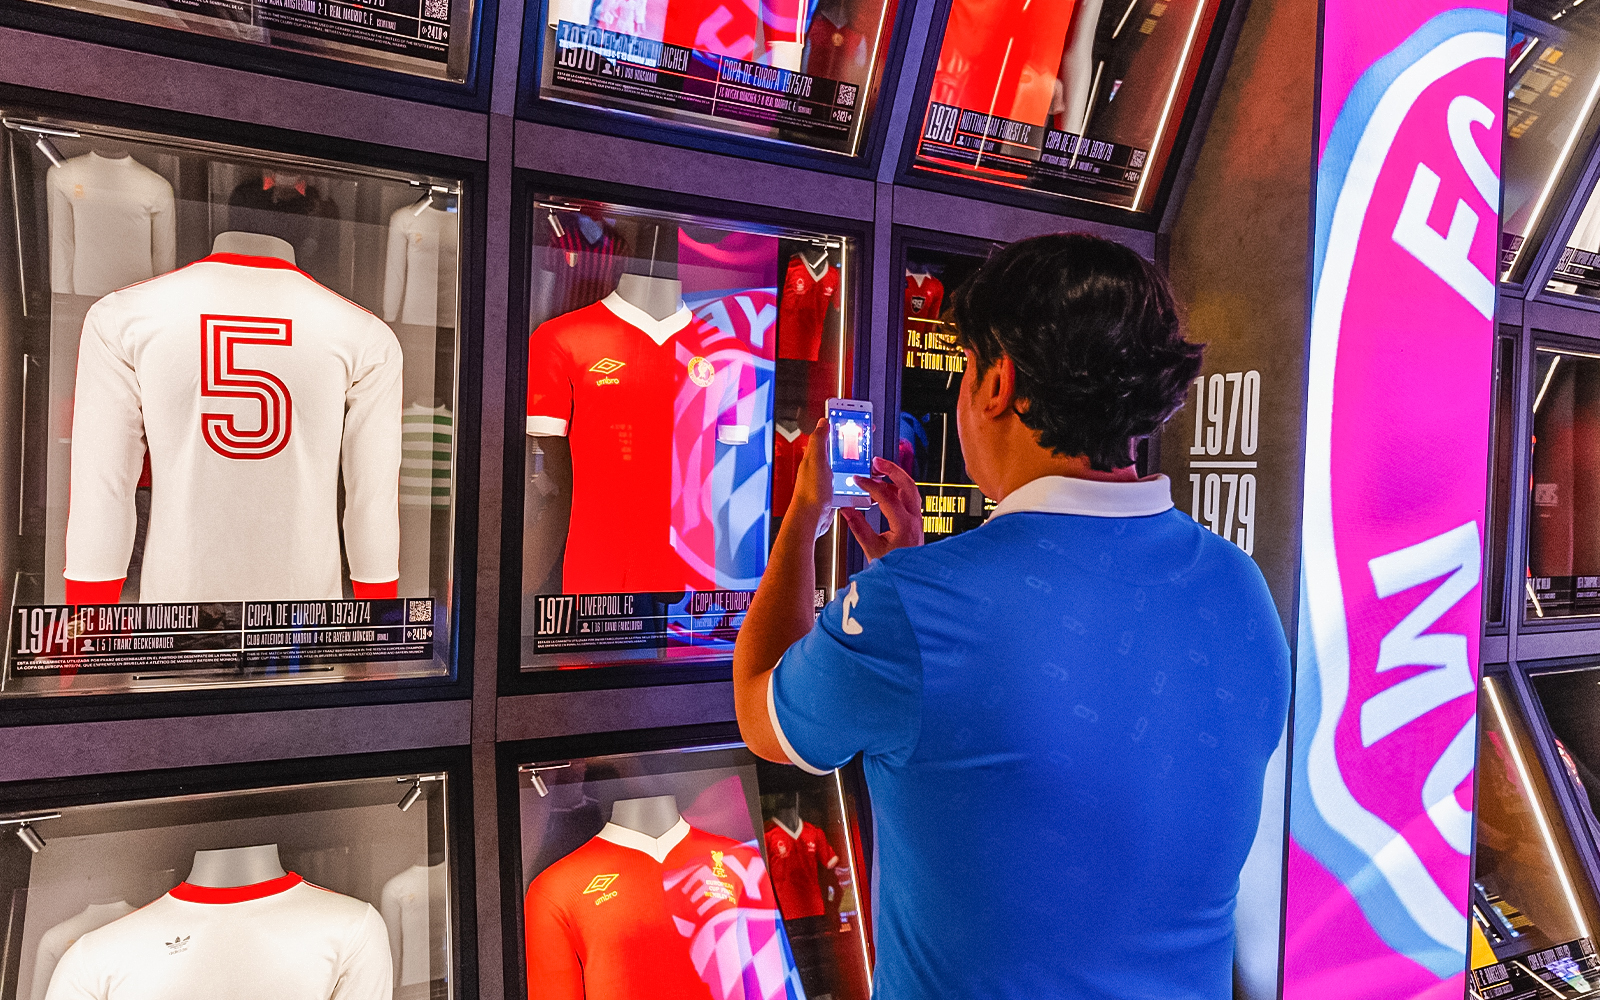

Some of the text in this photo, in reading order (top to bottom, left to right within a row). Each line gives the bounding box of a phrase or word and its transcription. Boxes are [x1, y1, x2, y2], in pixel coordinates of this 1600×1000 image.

[722, 59, 741, 82] COPA
[742, 63, 752, 85] DE
[753, 66, 779, 90] EUROPA
[925, 104, 958, 142] 1979
[906, 351, 915, 368] AL
[200, 314, 292, 460] 5
[1190, 370, 1261, 456] 1970
[926, 496, 965, 514] WELCOME TO
[1189, 473, 1257, 557] 1979
[247, 602, 371, 627] COPA DE EUROPA 1973/74
[580, 595, 634, 617] LIVERPOOL FC
[695, 592, 750, 612] COPA DE EUROPA
[80, 603, 199, 631] FC BAYERN MÜNCHEN
[537, 597, 573, 635] 1977
[17, 607, 69, 654] 1974
[247, 634, 260, 646] CLUB
[285, 633, 292, 645] DE
[293, 632, 312, 644] MADRID
[333, 630, 351, 643] BAYERN
[412, 628, 427, 641] 2419
[114, 638, 132, 651] FRANZ
[133, 637, 174, 650] BECKENBAUER
[595, 891, 618, 906] umbro
